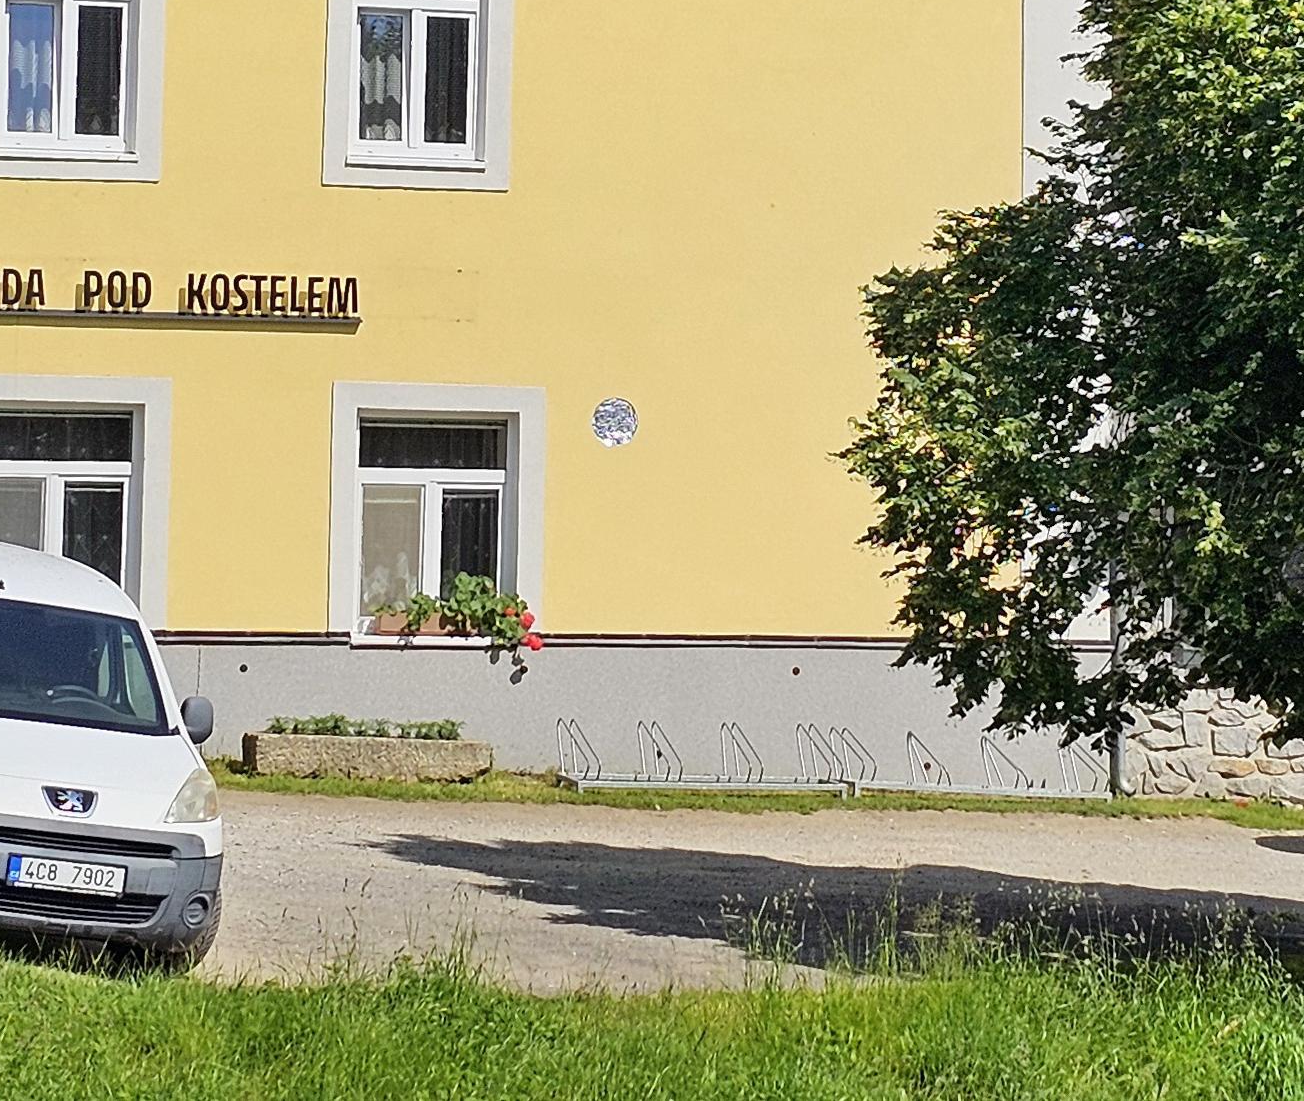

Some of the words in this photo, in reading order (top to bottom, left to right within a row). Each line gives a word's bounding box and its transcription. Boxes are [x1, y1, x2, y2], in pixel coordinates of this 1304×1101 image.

[83, 270, 152, 309] POD
[186, 273, 358, 314] KOSTELEM
[71, 866, 115, 888] 7902
